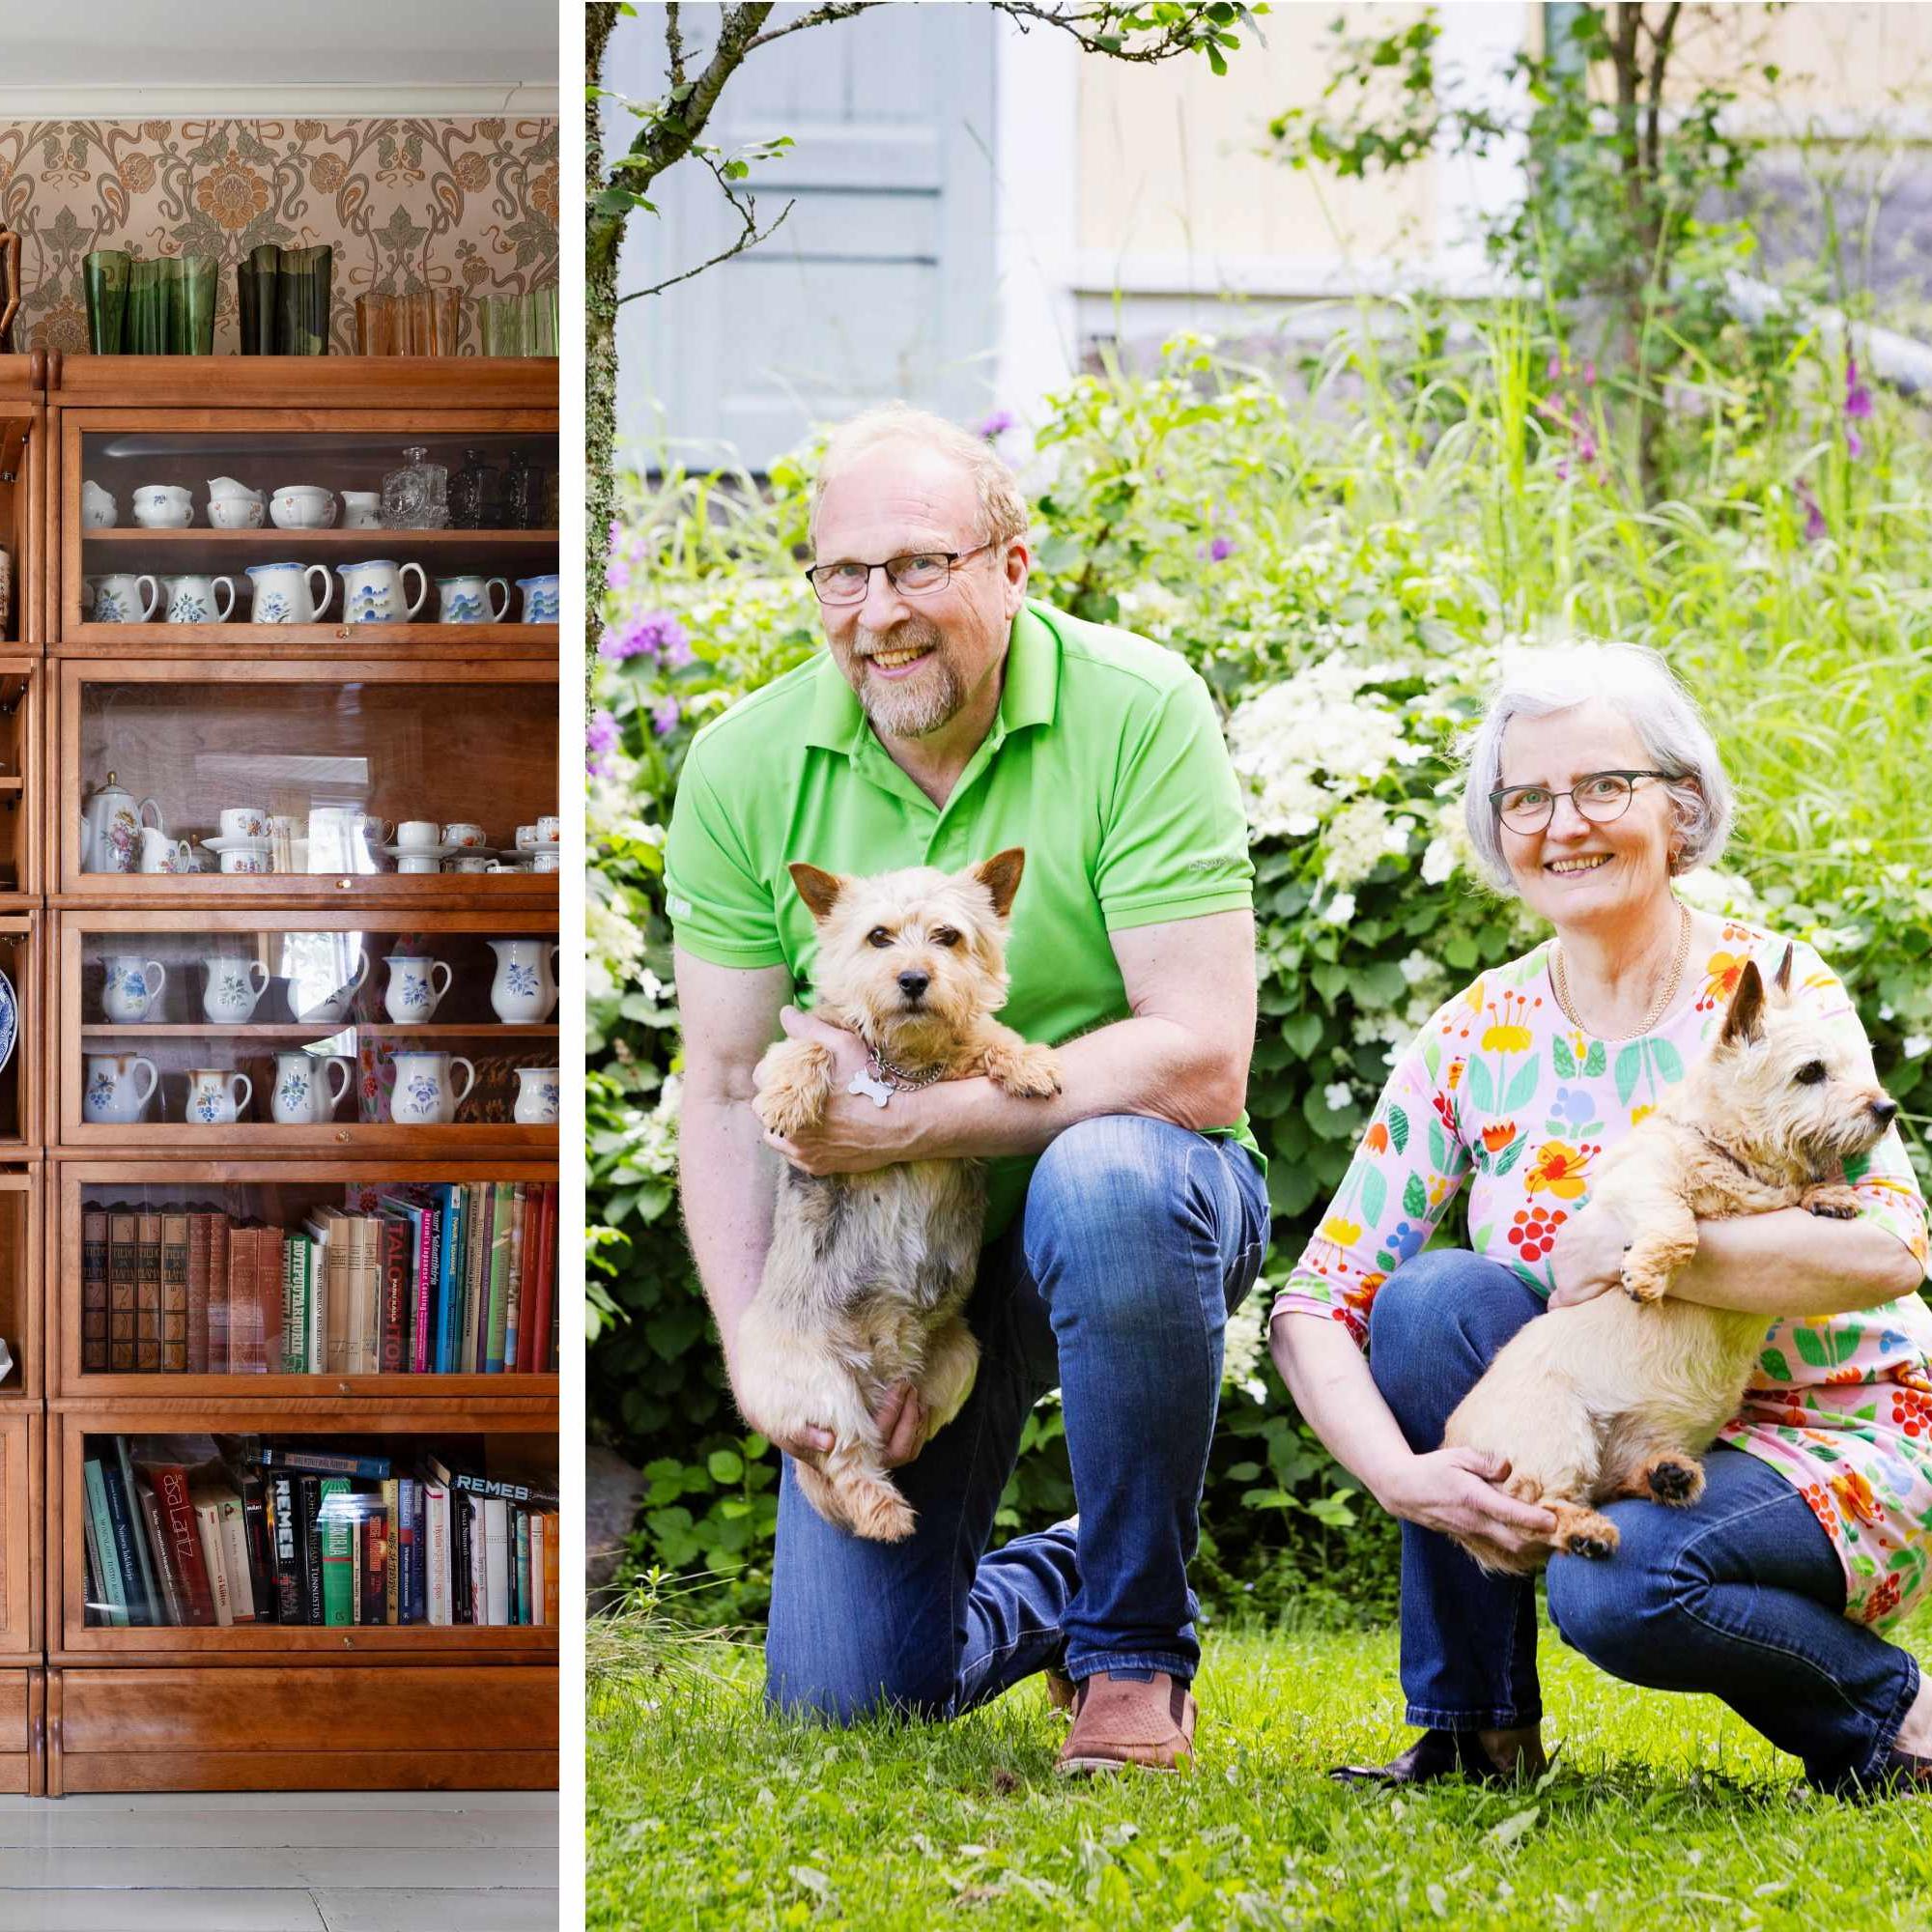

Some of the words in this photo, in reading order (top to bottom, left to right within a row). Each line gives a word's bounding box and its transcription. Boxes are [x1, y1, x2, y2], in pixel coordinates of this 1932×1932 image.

[423, 1212, 432, 1245] Harumi's
[421, 1247, 430, 1280] Japanese
[292, 1239, 305, 1355] KOTIPUUTARHURIN
[419, 1282, 429, 1312] Cooking
[456, 1474, 528, 1501] REMES
[276, 1480, 295, 1559] REMES
[306, 1492, 316, 1519] JOHN
[308, 1520, 318, 1564] GRISHAM
[311, 1567, 321, 1619] TUNNUSTUS
